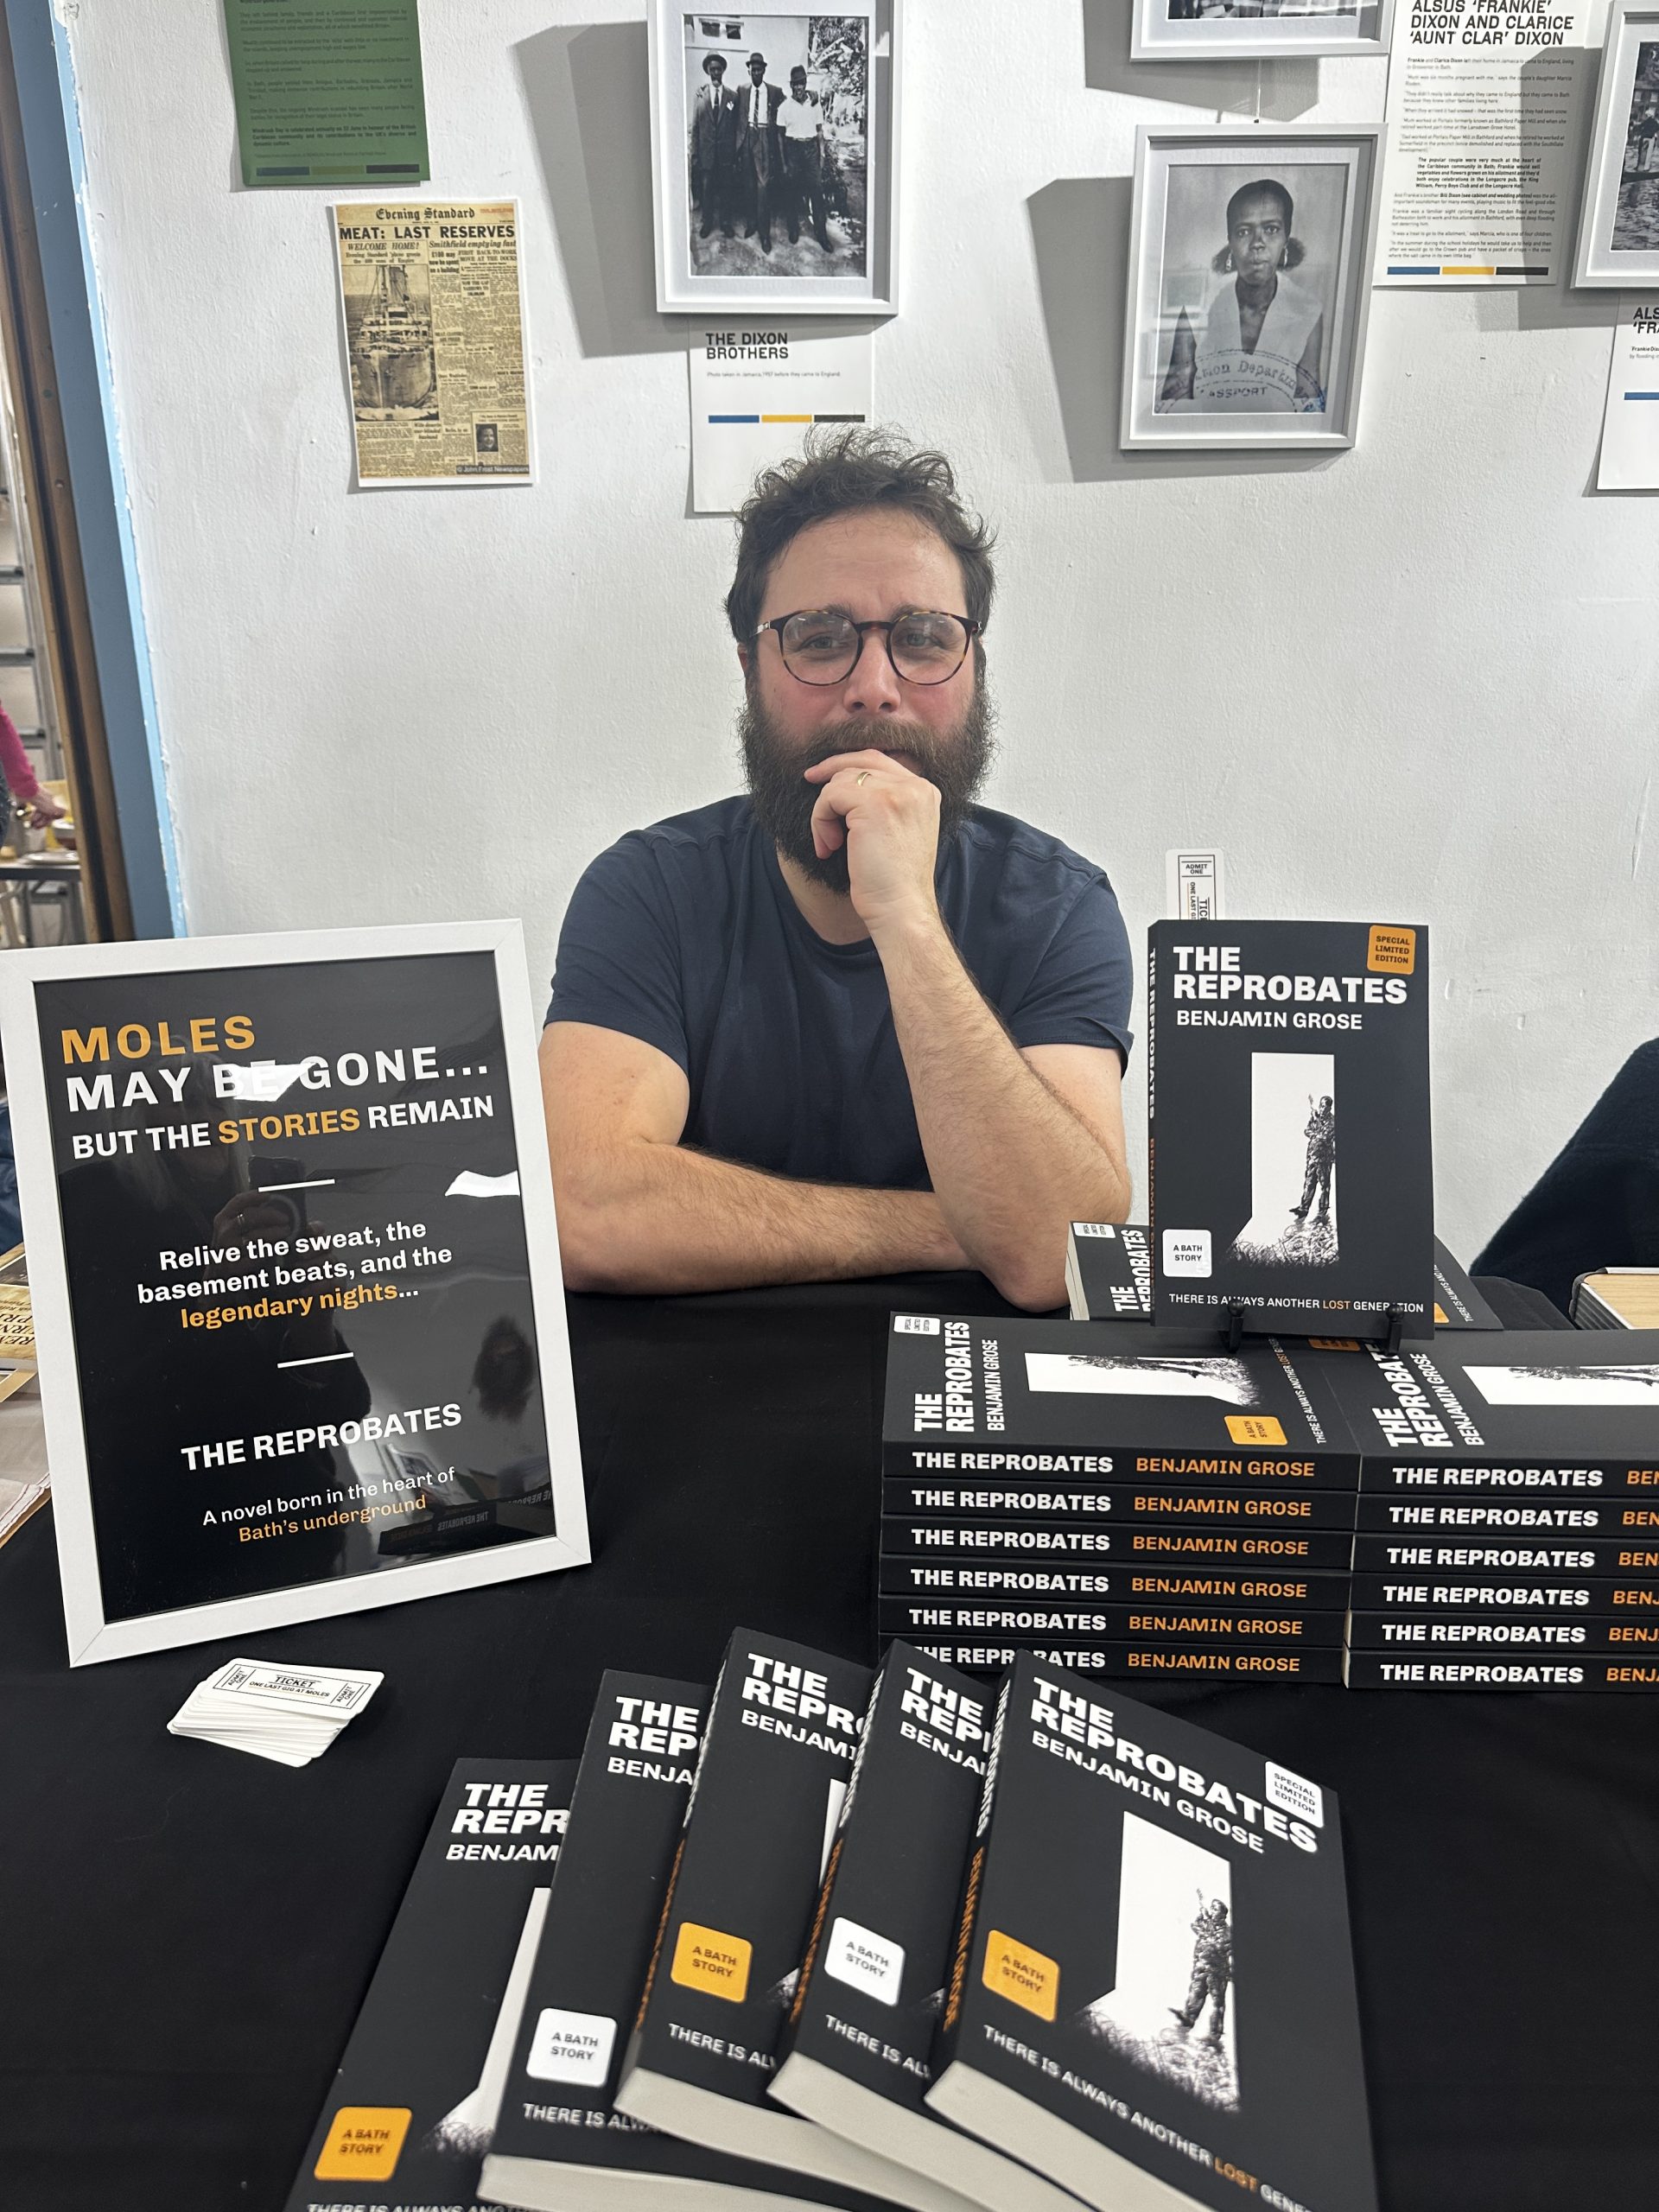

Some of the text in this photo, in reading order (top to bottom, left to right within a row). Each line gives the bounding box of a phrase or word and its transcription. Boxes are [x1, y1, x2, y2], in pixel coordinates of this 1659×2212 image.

[1412, 0, 1465, 12] ALSUS
[1411, 15, 1573, 29] DIXON AND CLARICE
[1515, 32, 1564, 45] DIXON
[376, 208, 421, 220] Evening
[424, 207, 475, 219] Standard
[340, 226, 515, 239] MEAT: LAST RESERVES
[347, 242, 387, 251] WELCOME
[706, 333, 788, 345] THE DIXON
[706, 346, 789, 359] BROTHERS
[1375, 945, 1410, 955] LIMITED
[1376, 936, 1411, 945] SPECIAL
[1173, 946, 1241, 972] THE
[1375, 955, 1409, 964] EDITION
[1173, 975, 1408, 1005] REPROBATES
[1177, 1010, 1363, 1030] BENJAMIN GROSE
[60, 1015, 256, 1065] MOLES
[66, 1046, 488, 1113] MAY BE GONE...
[72, 1095, 494, 1160] BUT THE STORIES REMAIN
[159, 1220, 427, 1271] Relive the sweat, the
[1174, 1253, 1202, 1262] STORY
[1181, 1244, 1203, 1253] BATH
[137, 1246, 453, 1305] basement beats, and the
[180, 1282, 419, 1330] legendary nights...
[1169, 1294, 1205, 1304] THERE
[1207, 1295, 1218, 1305] IS
[1267, 1298, 1320, 1308] ANOTHER
[1323, 1300, 1351, 1310] LOST
[944, 1322, 975, 1432] REPROBATES
[982, 1338, 1005, 1431] BENJAMIN GROSE
[914, 1393, 943, 1432] THE
[1410, 1353, 1485, 1446] BENJAMIN GROSE
[181, 1403, 463, 1471] THE REPROBATES
[1244, 1421, 1255, 1433] BATH
[1255, 1421, 1268, 1438] STORY
[1372, 1408, 1418, 1447] THE
[912, 1452, 1315, 1477] THE REPROBATES BENJAMIN GROSE
[1392, 1467, 1603, 1487] THE REPROBATES
[202, 1465, 455, 1526] A novel born in the heart of
[912, 1490, 1312, 1516] THE REPROBATES BENJAMIN GROSE
[303, 1495, 427, 1531] underground
[1389, 1507, 1599, 1528] THE REPROBATES
[911, 1529, 1308, 1555] THE REPROBATES BENJAMIN GROSE
[1387, 1548, 1595, 1568] THE REPROBATES
[911, 1569, 1306, 1598] THE REPROBATES BENJAMIN GROSE
[1382, 1586, 1590, 1605] THE REPROBATES
[747, 1652, 828, 1698] THE
[1128, 1653, 1300, 1671] BENJAMIN GROSE
[1381, 1664, 1584, 1683] THE REPROBATES
[274, 1676, 316, 1688] TICKET
[906, 1667, 984, 1726] THE
[1033, 1676, 1114, 1732] THE
[615, 1695, 700, 1732] THE
[1030, 1699, 1318, 1853] REPROBATES
[1274, 1772, 1315, 1798] SPECIAL
[1033, 1730, 1265, 1853] BENJAMIN GROSE
[1273, 1781, 1316, 1807] LIMITED
[1274, 1789, 1316, 1815] EDITION
[692, 1945, 737, 1966] A BATH
[692, 1958, 734, 1978] STORY
[1001, 1954, 1045, 1982] A BATH
[1001, 1966, 1042, 1993] STORY
[552, 2032, 599, 2047] A BATH
[550, 2045, 595, 2061] STORY
[983, 2024, 1258, 2193] THERE IS ALWAYS ANOTHER LOST
